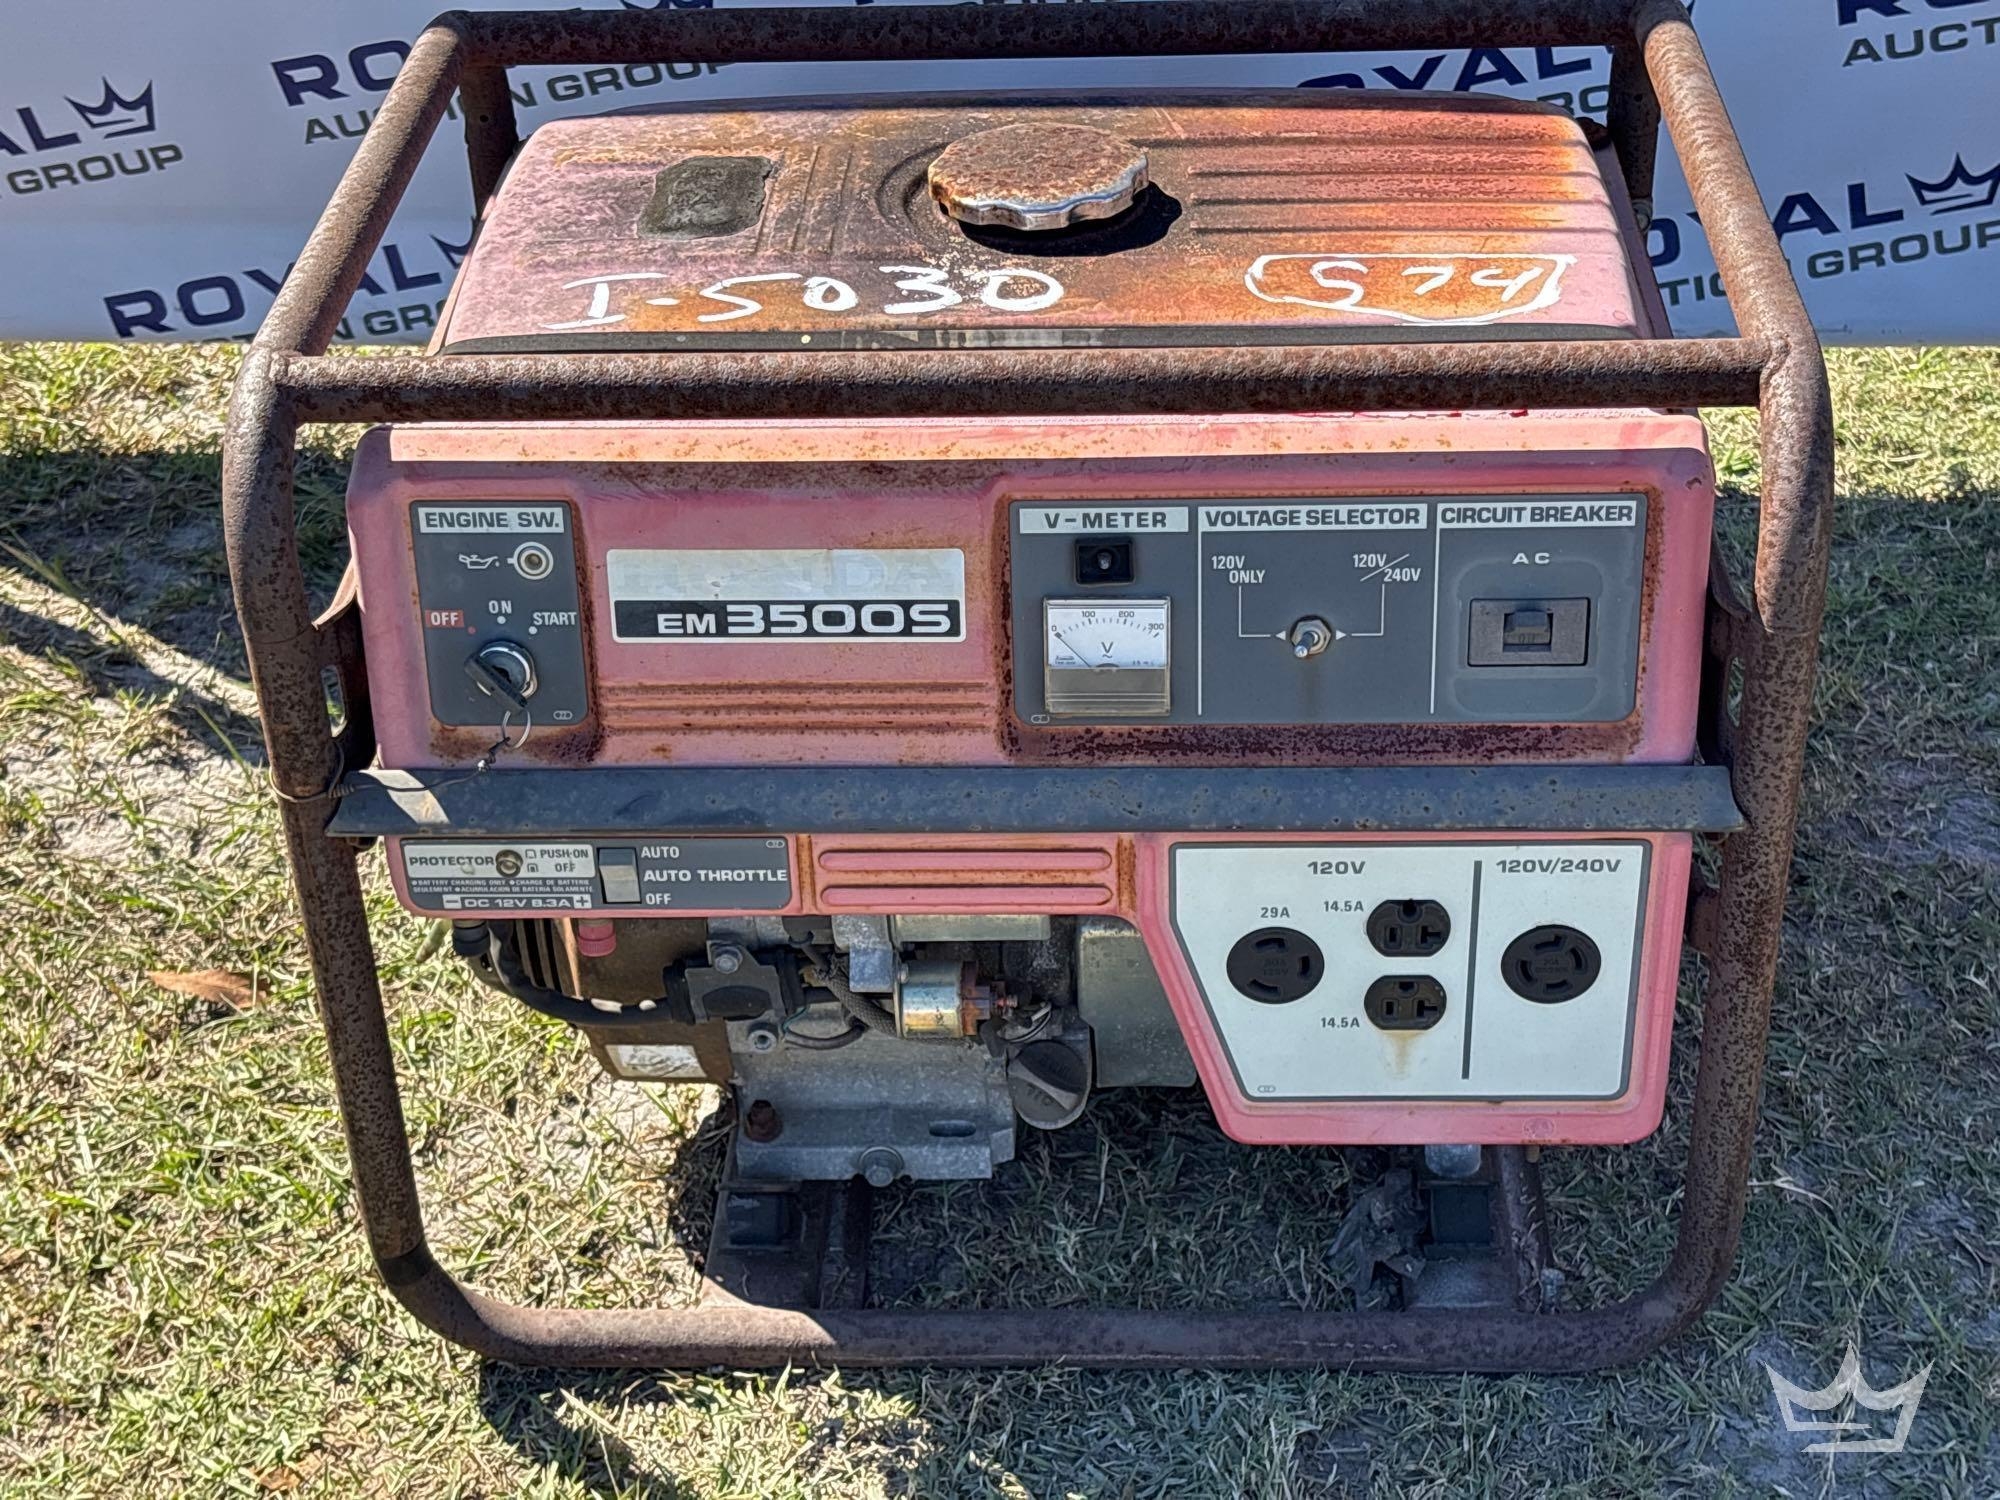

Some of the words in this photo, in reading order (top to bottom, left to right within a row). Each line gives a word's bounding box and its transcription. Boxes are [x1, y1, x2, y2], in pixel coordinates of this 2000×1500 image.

[6, 144, 183, 195] GROUP
[424, 511, 508, 528] ENGINE
[517, 511, 560, 528] SW.
[1205, 508, 1301, 527] VOLTAGE
[1305, 507, 1420, 526] SELECTOR
[1440, 505, 1527, 524] CIRCUIT
[1529, 504, 1633, 524] BREAKER
[1211, 554, 1245, 570] 120V
[1229, 569, 1265, 584] ONLY
[488, 599, 513, 615] ON
[430, 611, 459, 626] OFF
[532, 611, 578, 626] START
[657, 612, 717, 635] EM
[726, 603, 951, 635] 3500S
[1081, 610, 1096, 619] 100
[1118, 610, 1135, 619] 200
[1051, 625, 1057, 633] 0
[1148, 622, 1164, 631] 300
[640, 846, 680, 859] AUTO
[409, 855, 495, 867] PROTECTOR
[555, 862, 576, 873] OFF
[1496, 858, 1621, 874] 120V/240V
[1307, 861, 1366, 875] 120V
[643, 869, 692, 882] AUTO
[696, 869, 788, 882] THROTTLE
[464, 898, 490, 908] DC
[494, 898, 526, 908] 12V
[645, 893, 672, 905] OFF
[1260, 907, 1290, 918] 29A
[1323, 900, 1364, 912] 14.5A
[1321, 1016, 1360, 1028] 14.5A
